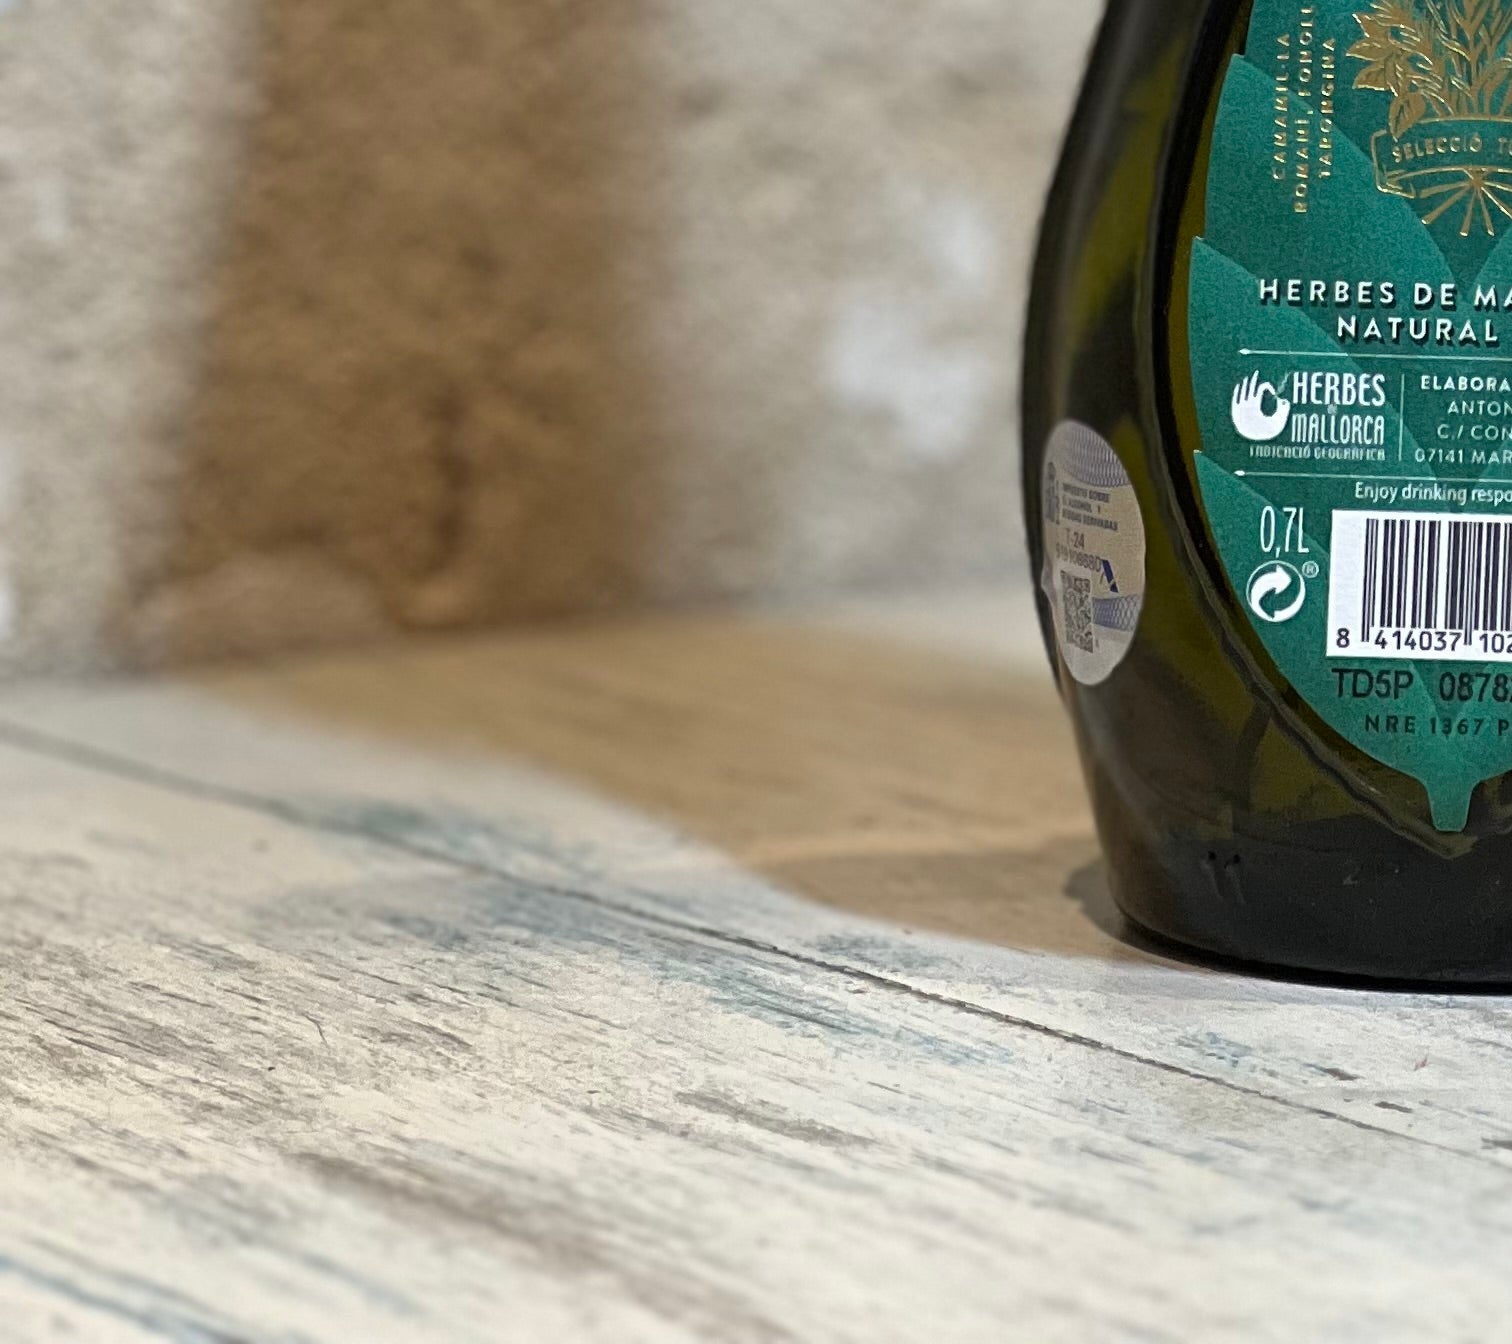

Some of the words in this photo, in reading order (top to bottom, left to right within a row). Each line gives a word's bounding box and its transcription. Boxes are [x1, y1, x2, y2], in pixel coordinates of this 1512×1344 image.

[1392, 132, 1483, 163] SELECCIÓ
[1259, 278, 1395, 306] HERBES
[1413, 283, 1456, 308] DE
[1336, 315, 1499, 343] NATURAL
[1292, 371, 1386, 407] HERBES
[1291, 413, 1385, 445] MALLORCA
[1414, 448, 1464, 463] 07141
[1355, 481, 1397, 504] Enjoy
[1402, 483, 1467, 505] drinking
[1260, 505, 1310, 558] 0,7L
[1335, 628, 1350, 649] 8
[1373, 629, 1463, 653] 414037
[1331, 668, 1414, 700] TD5P
[1365, 715, 1417, 734] NRE
[1429, 717, 1485, 736] 1367
